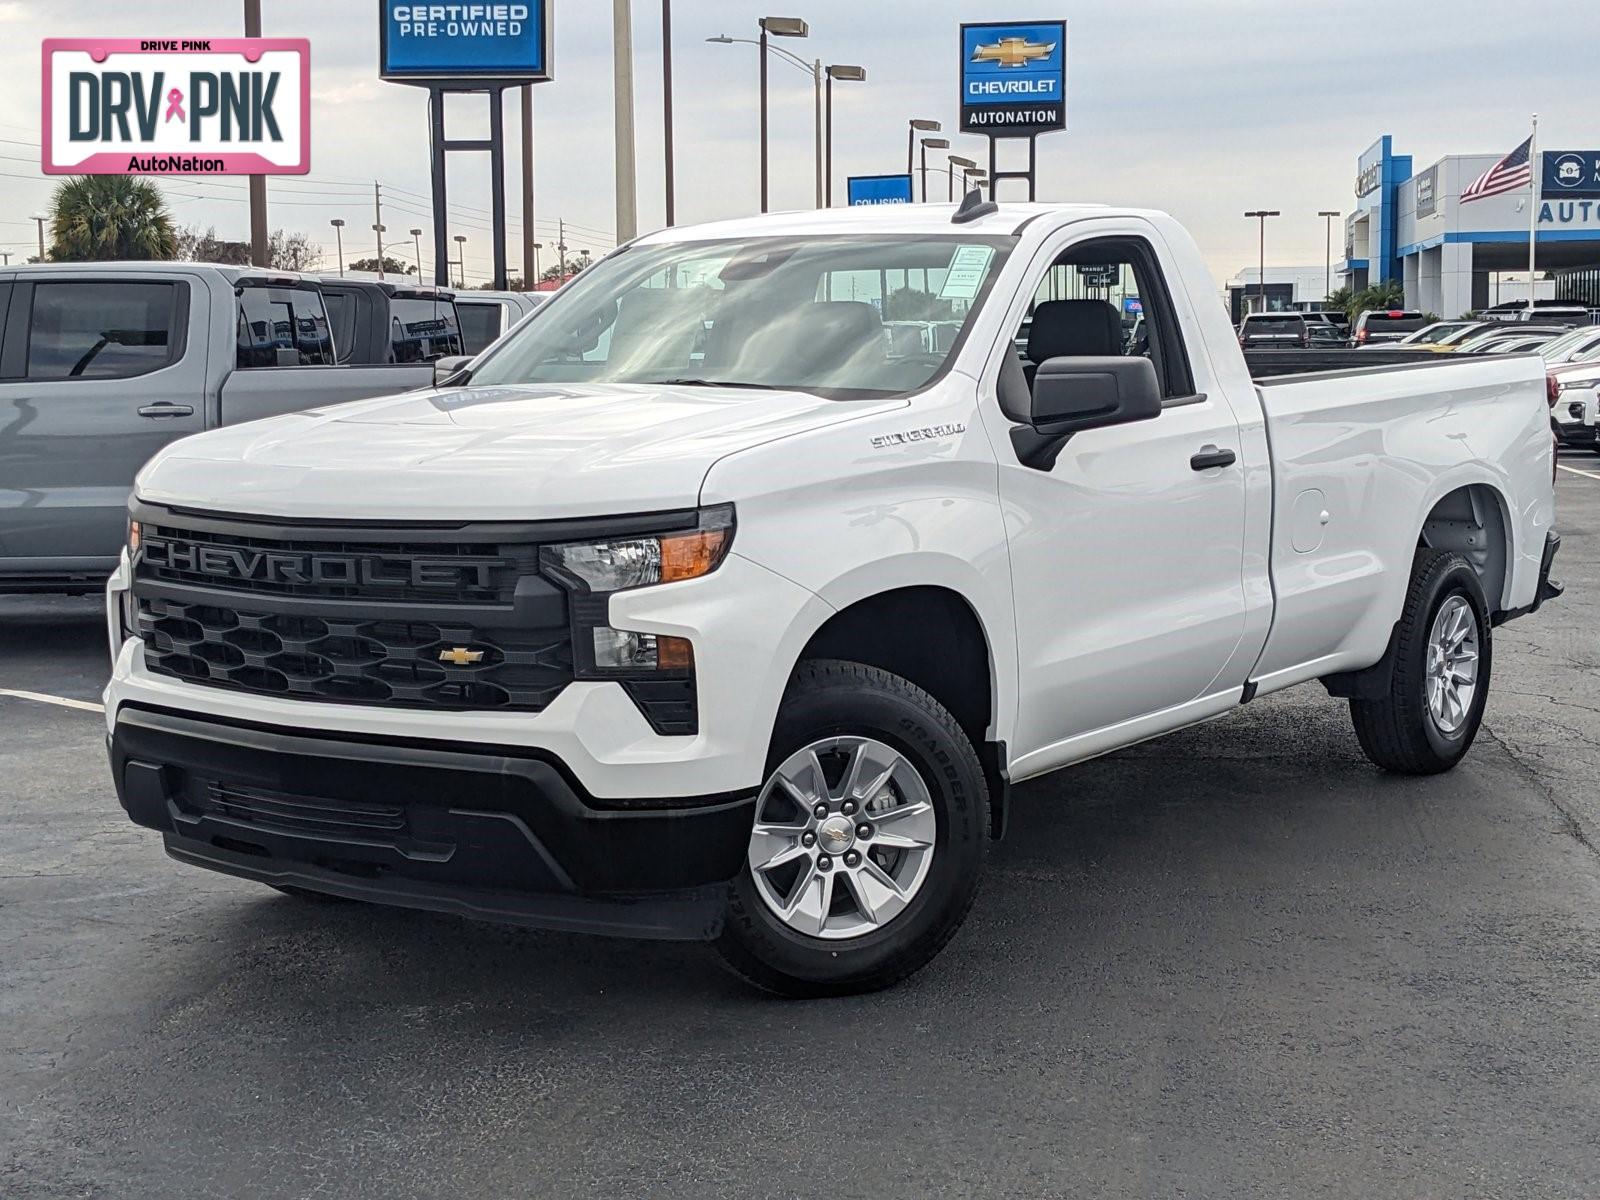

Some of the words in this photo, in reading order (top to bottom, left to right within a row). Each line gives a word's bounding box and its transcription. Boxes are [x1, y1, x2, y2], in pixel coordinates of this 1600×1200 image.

[393, 5, 528, 21] CERTIFIED
[400, 22, 522, 37] PRE-OWNED
[969, 80, 1056, 94] CHEVROLET
[969, 110, 1056, 124] AUTONATION
[1538, 202, 1600, 223] AUT
[141, 538, 505, 588] CHEVROLET
